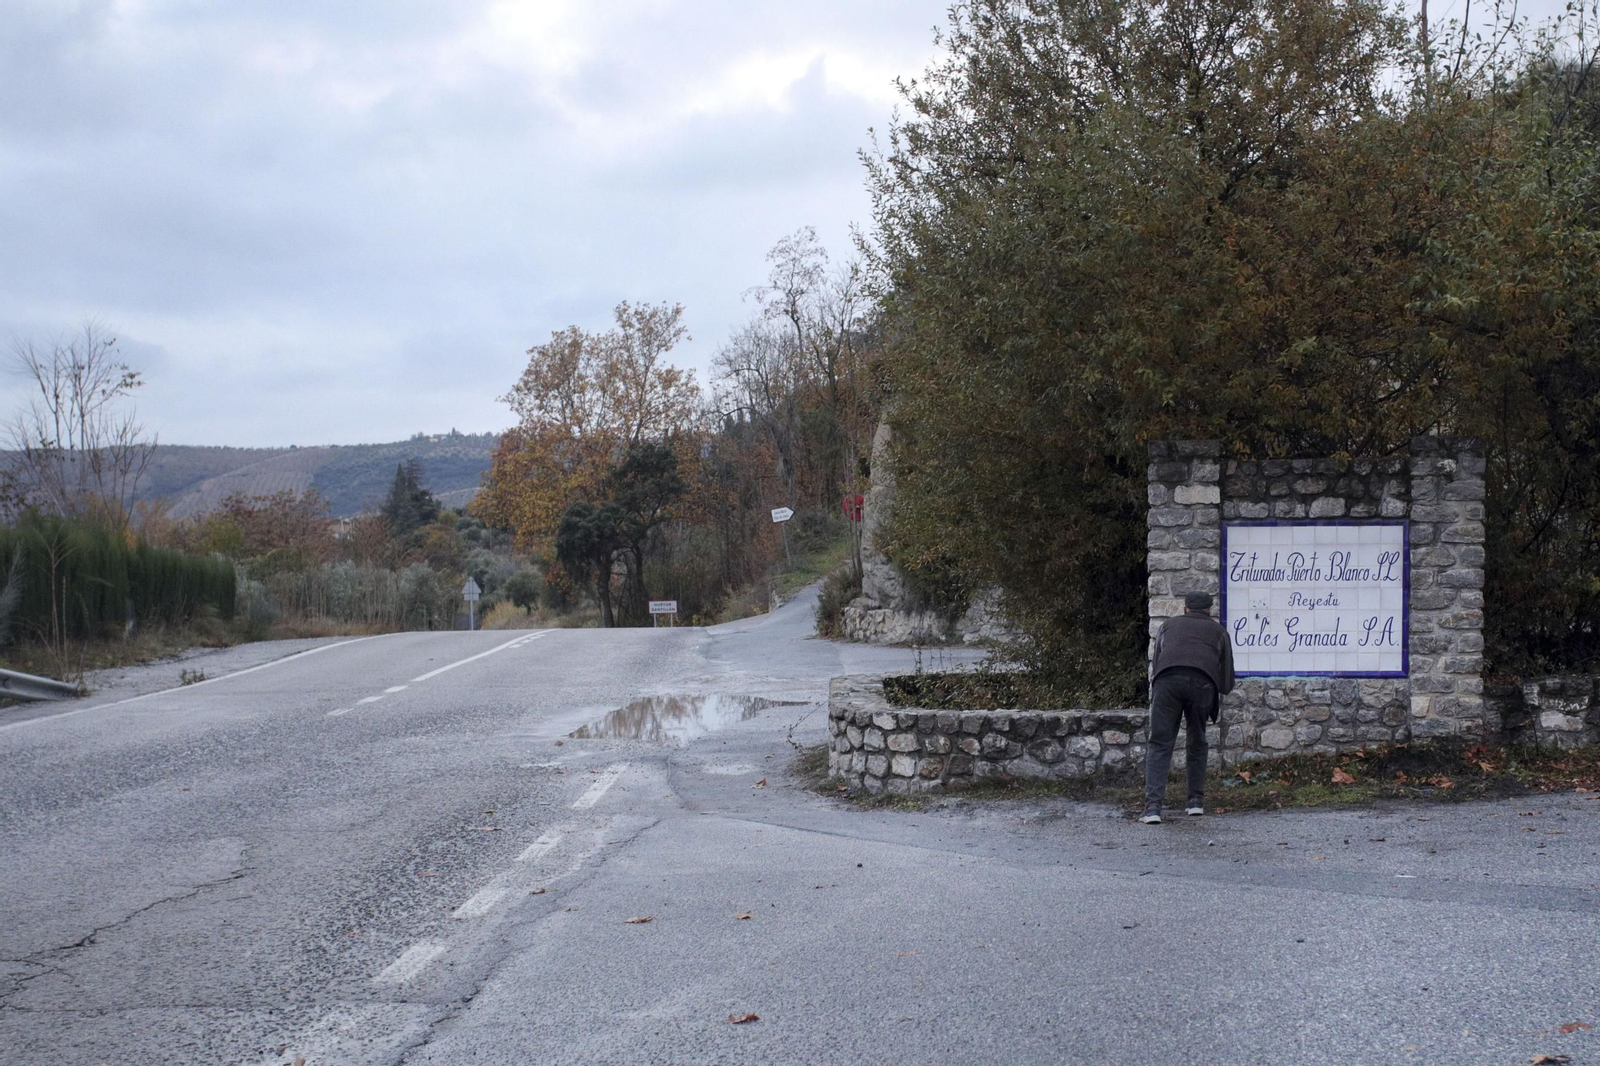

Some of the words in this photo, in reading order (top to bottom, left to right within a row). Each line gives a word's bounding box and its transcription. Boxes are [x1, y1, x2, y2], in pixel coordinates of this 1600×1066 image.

[1230, 551, 1285, 582] Triturados
[1287, 551, 1321, 582] Puerto
[1324, 550, 1370, 582] Blanco
[1233, 616, 1279, 647] Cales
[1285, 616, 1349, 652] Granada
